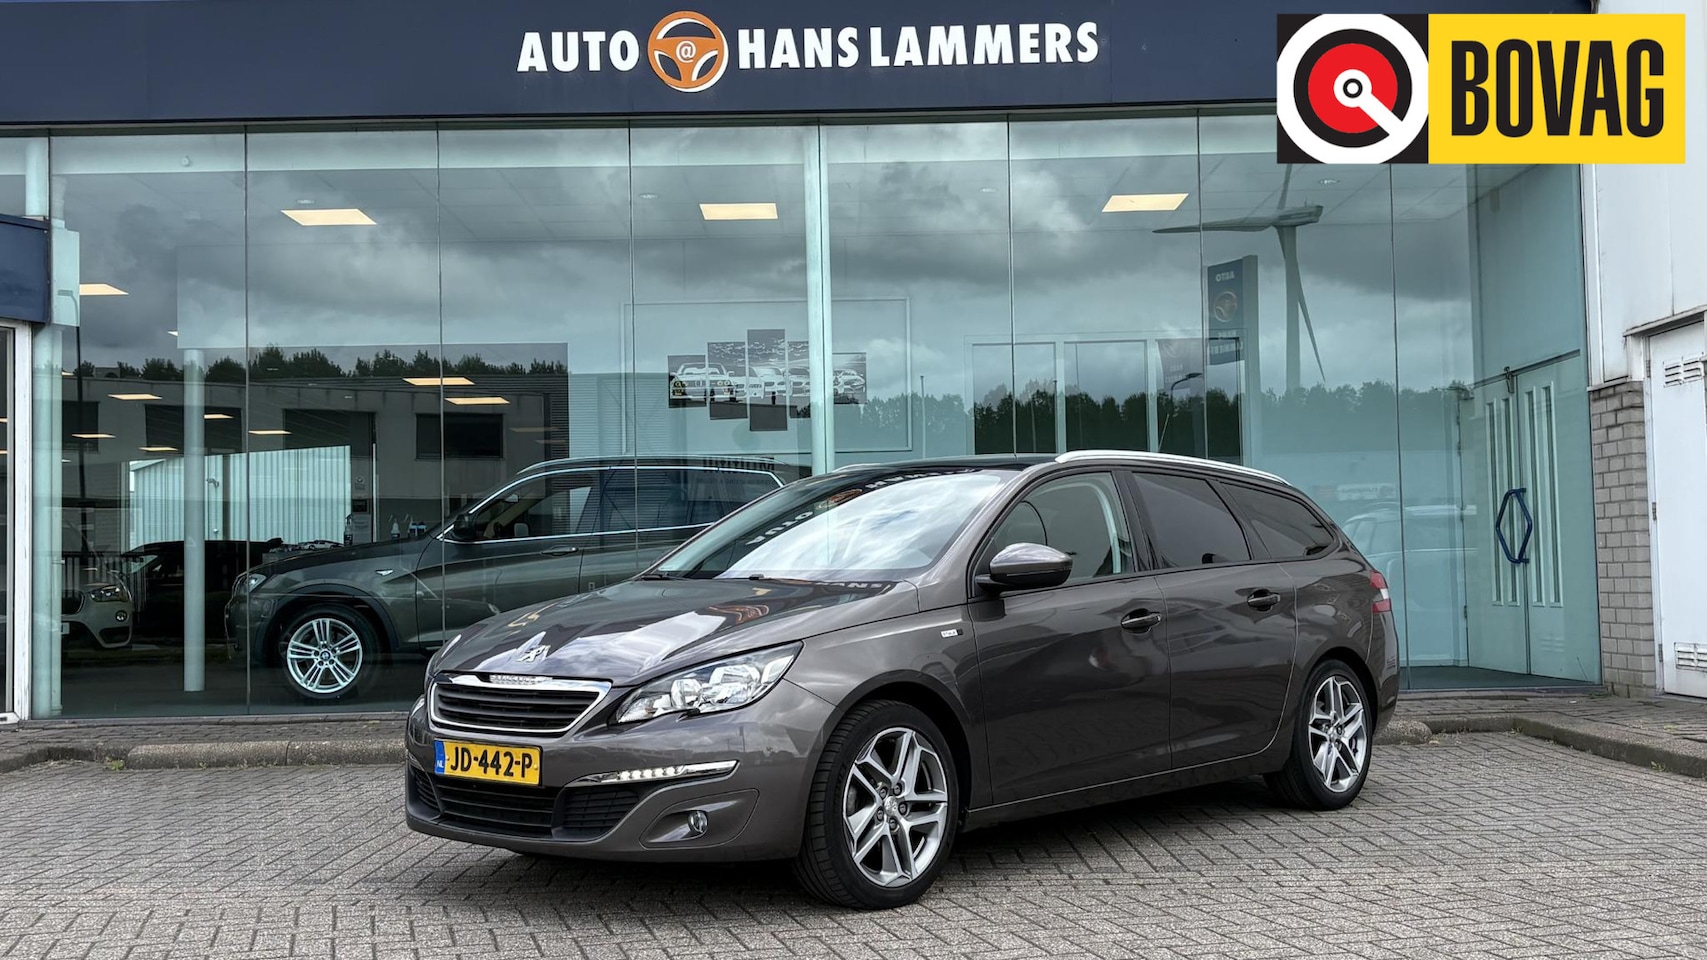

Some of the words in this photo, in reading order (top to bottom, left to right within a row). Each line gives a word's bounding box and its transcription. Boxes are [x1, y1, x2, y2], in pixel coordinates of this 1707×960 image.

[516, 30, 640, 74] AUTO
[676, 40, 697, 63] @
[738, 27, 859, 70] HANS
[869, 22, 1099, 68] LAMMERS
[436, 760, 444, 768] NL
[450, 746, 533, 778] JD-442-P
